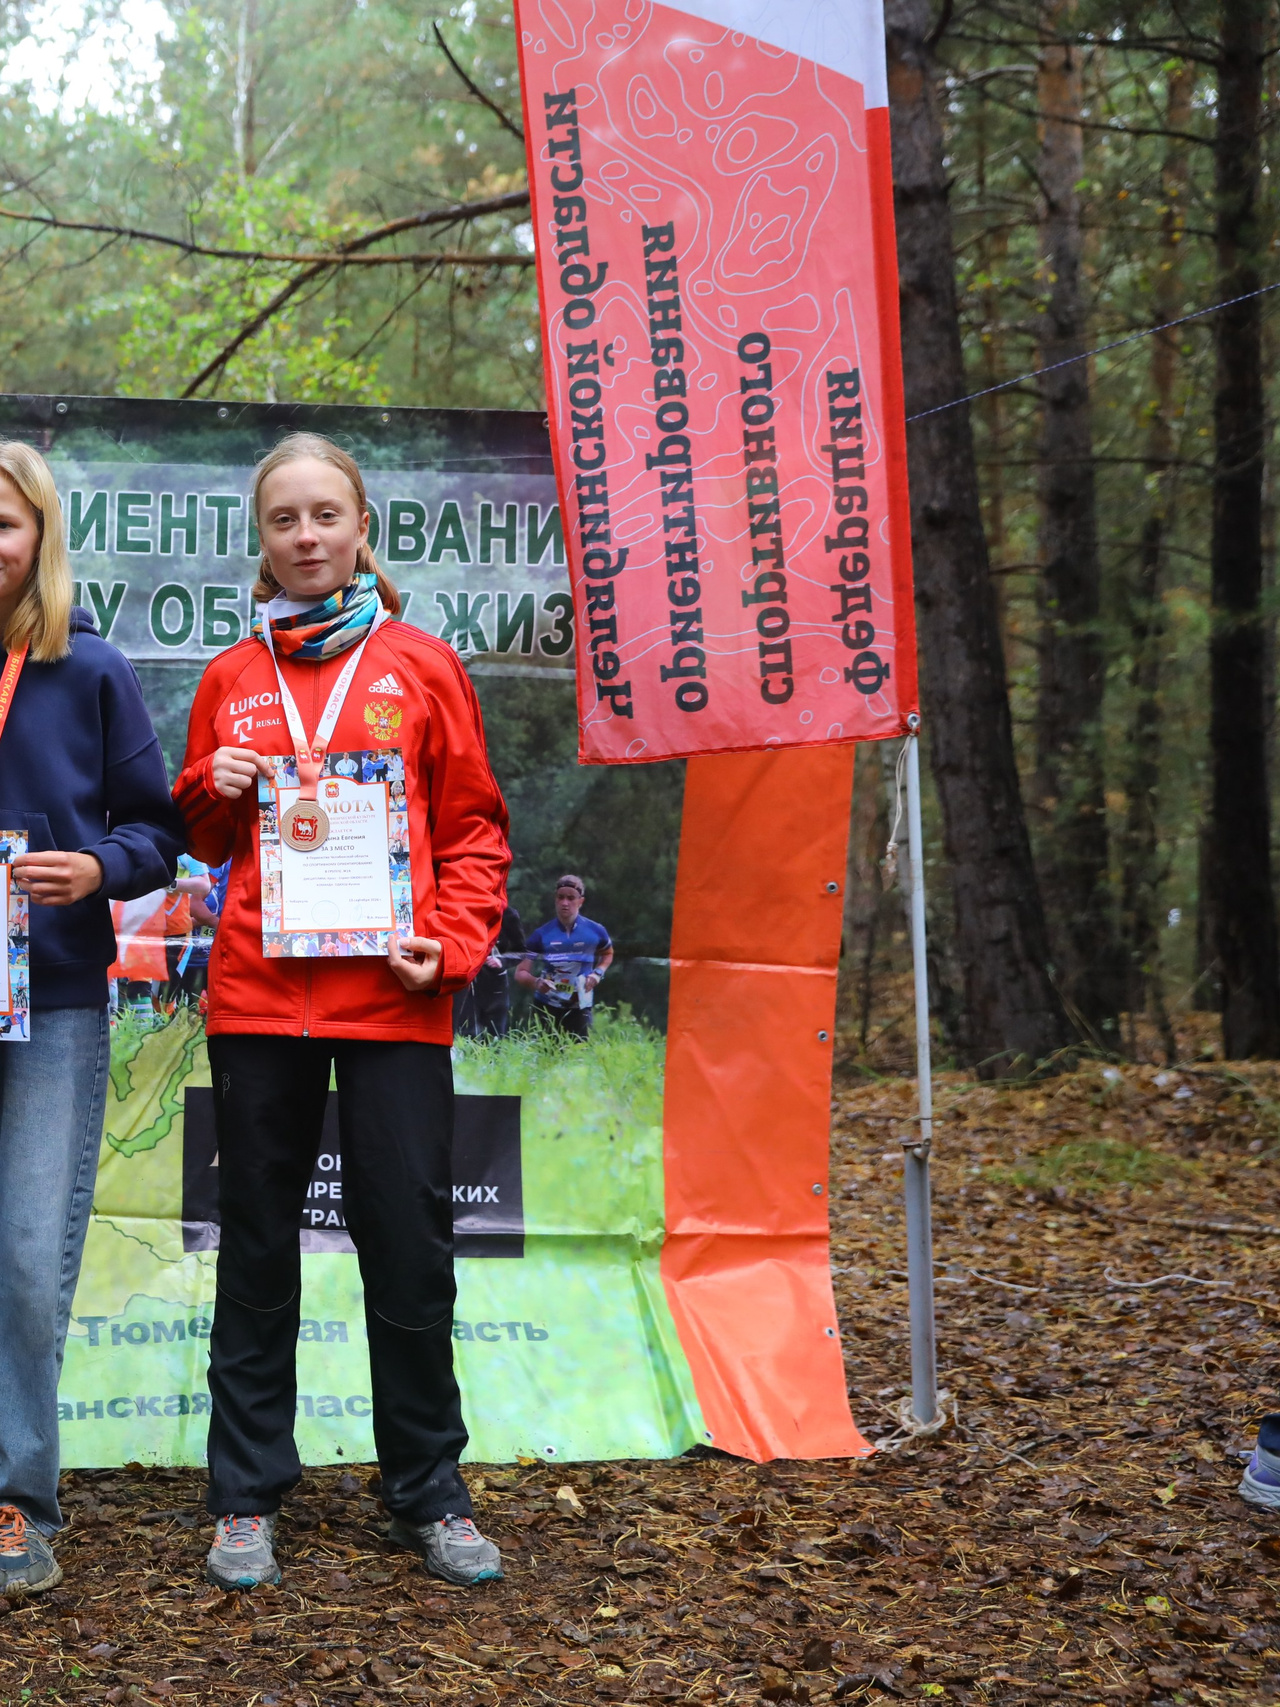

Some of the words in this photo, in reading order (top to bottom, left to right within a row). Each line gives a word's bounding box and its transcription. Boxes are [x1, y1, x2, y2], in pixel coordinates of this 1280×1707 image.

[436, 590, 575, 658] ЖИЗ
[368, 682, 403, 697] adidas
[229, 691, 284, 716] LUKOI
[256, 717, 282, 729] RUSAL
[323, 799, 375, 814] МОТА
[452, 1319, 550, 1342] асть
